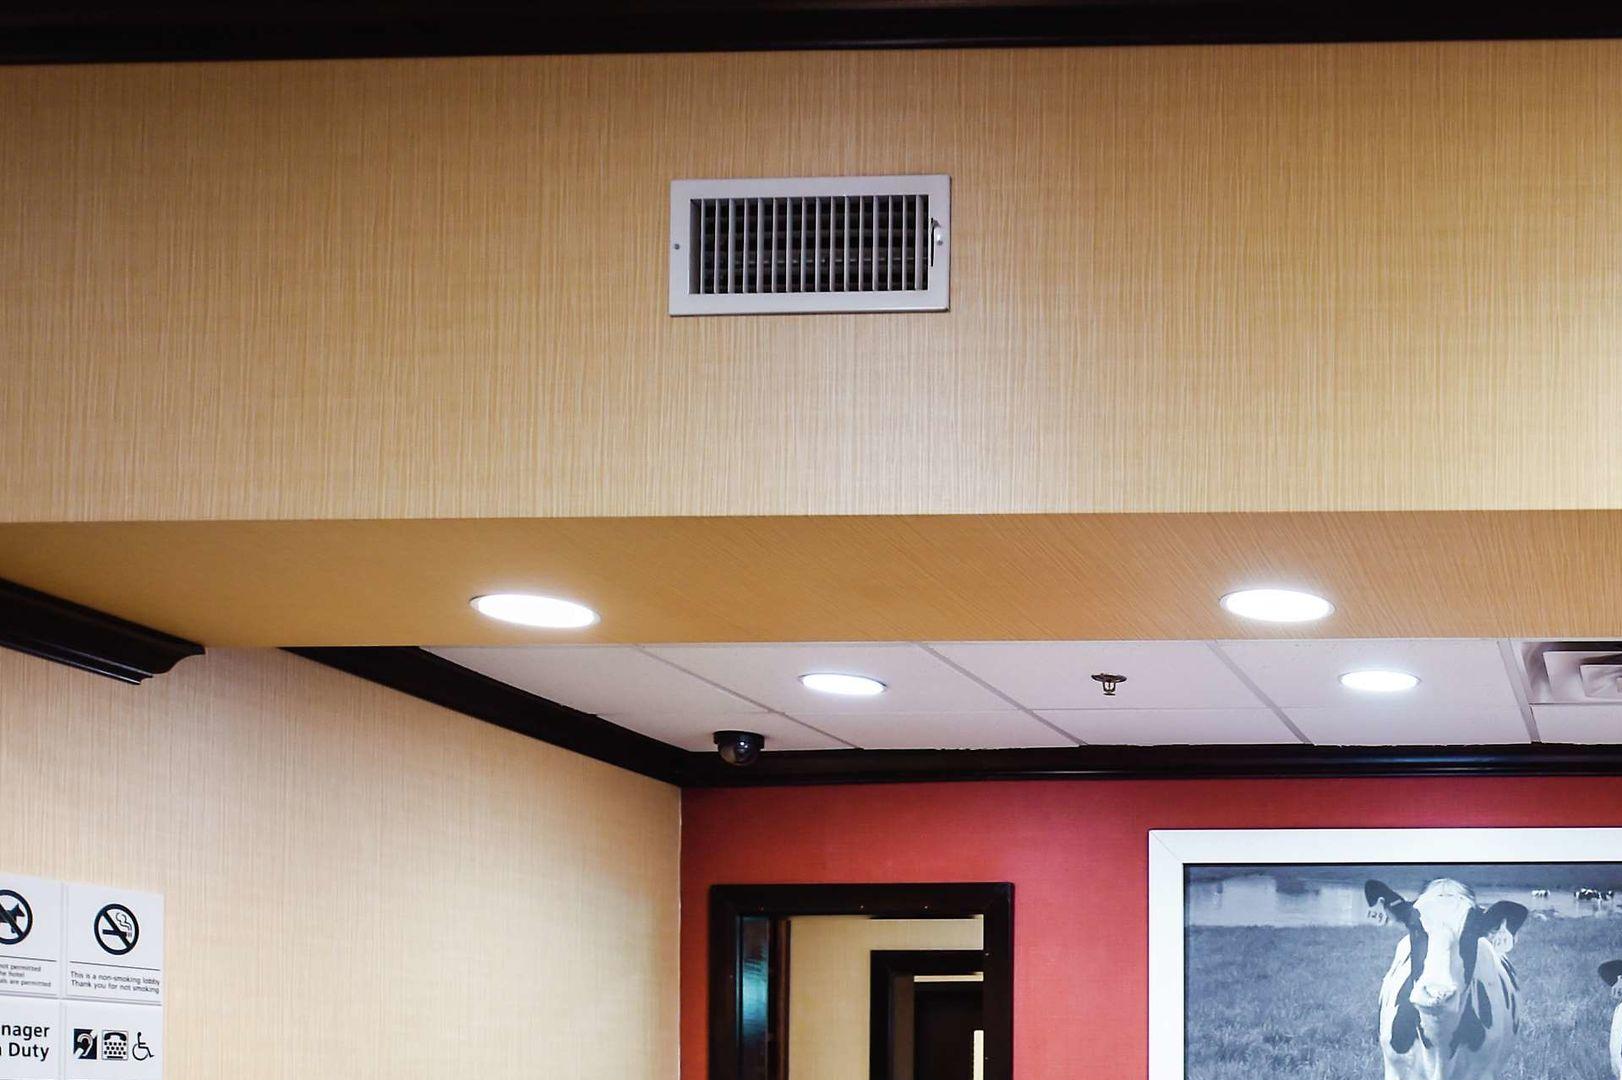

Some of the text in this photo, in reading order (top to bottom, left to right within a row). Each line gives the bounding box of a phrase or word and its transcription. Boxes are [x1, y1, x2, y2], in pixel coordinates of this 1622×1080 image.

[71, 970, 84, 979] This
[98, 974, 141, 985] non-smoking
[143, 976, 160, 986] lobby
[71, 979, 91, 987] Thank
[120, 983, 131, 991] not
[132, 985, 160, 994] smoking
[2, 1024, 50, 1041] nager
[9, 1042, 50, 1062] Duty
